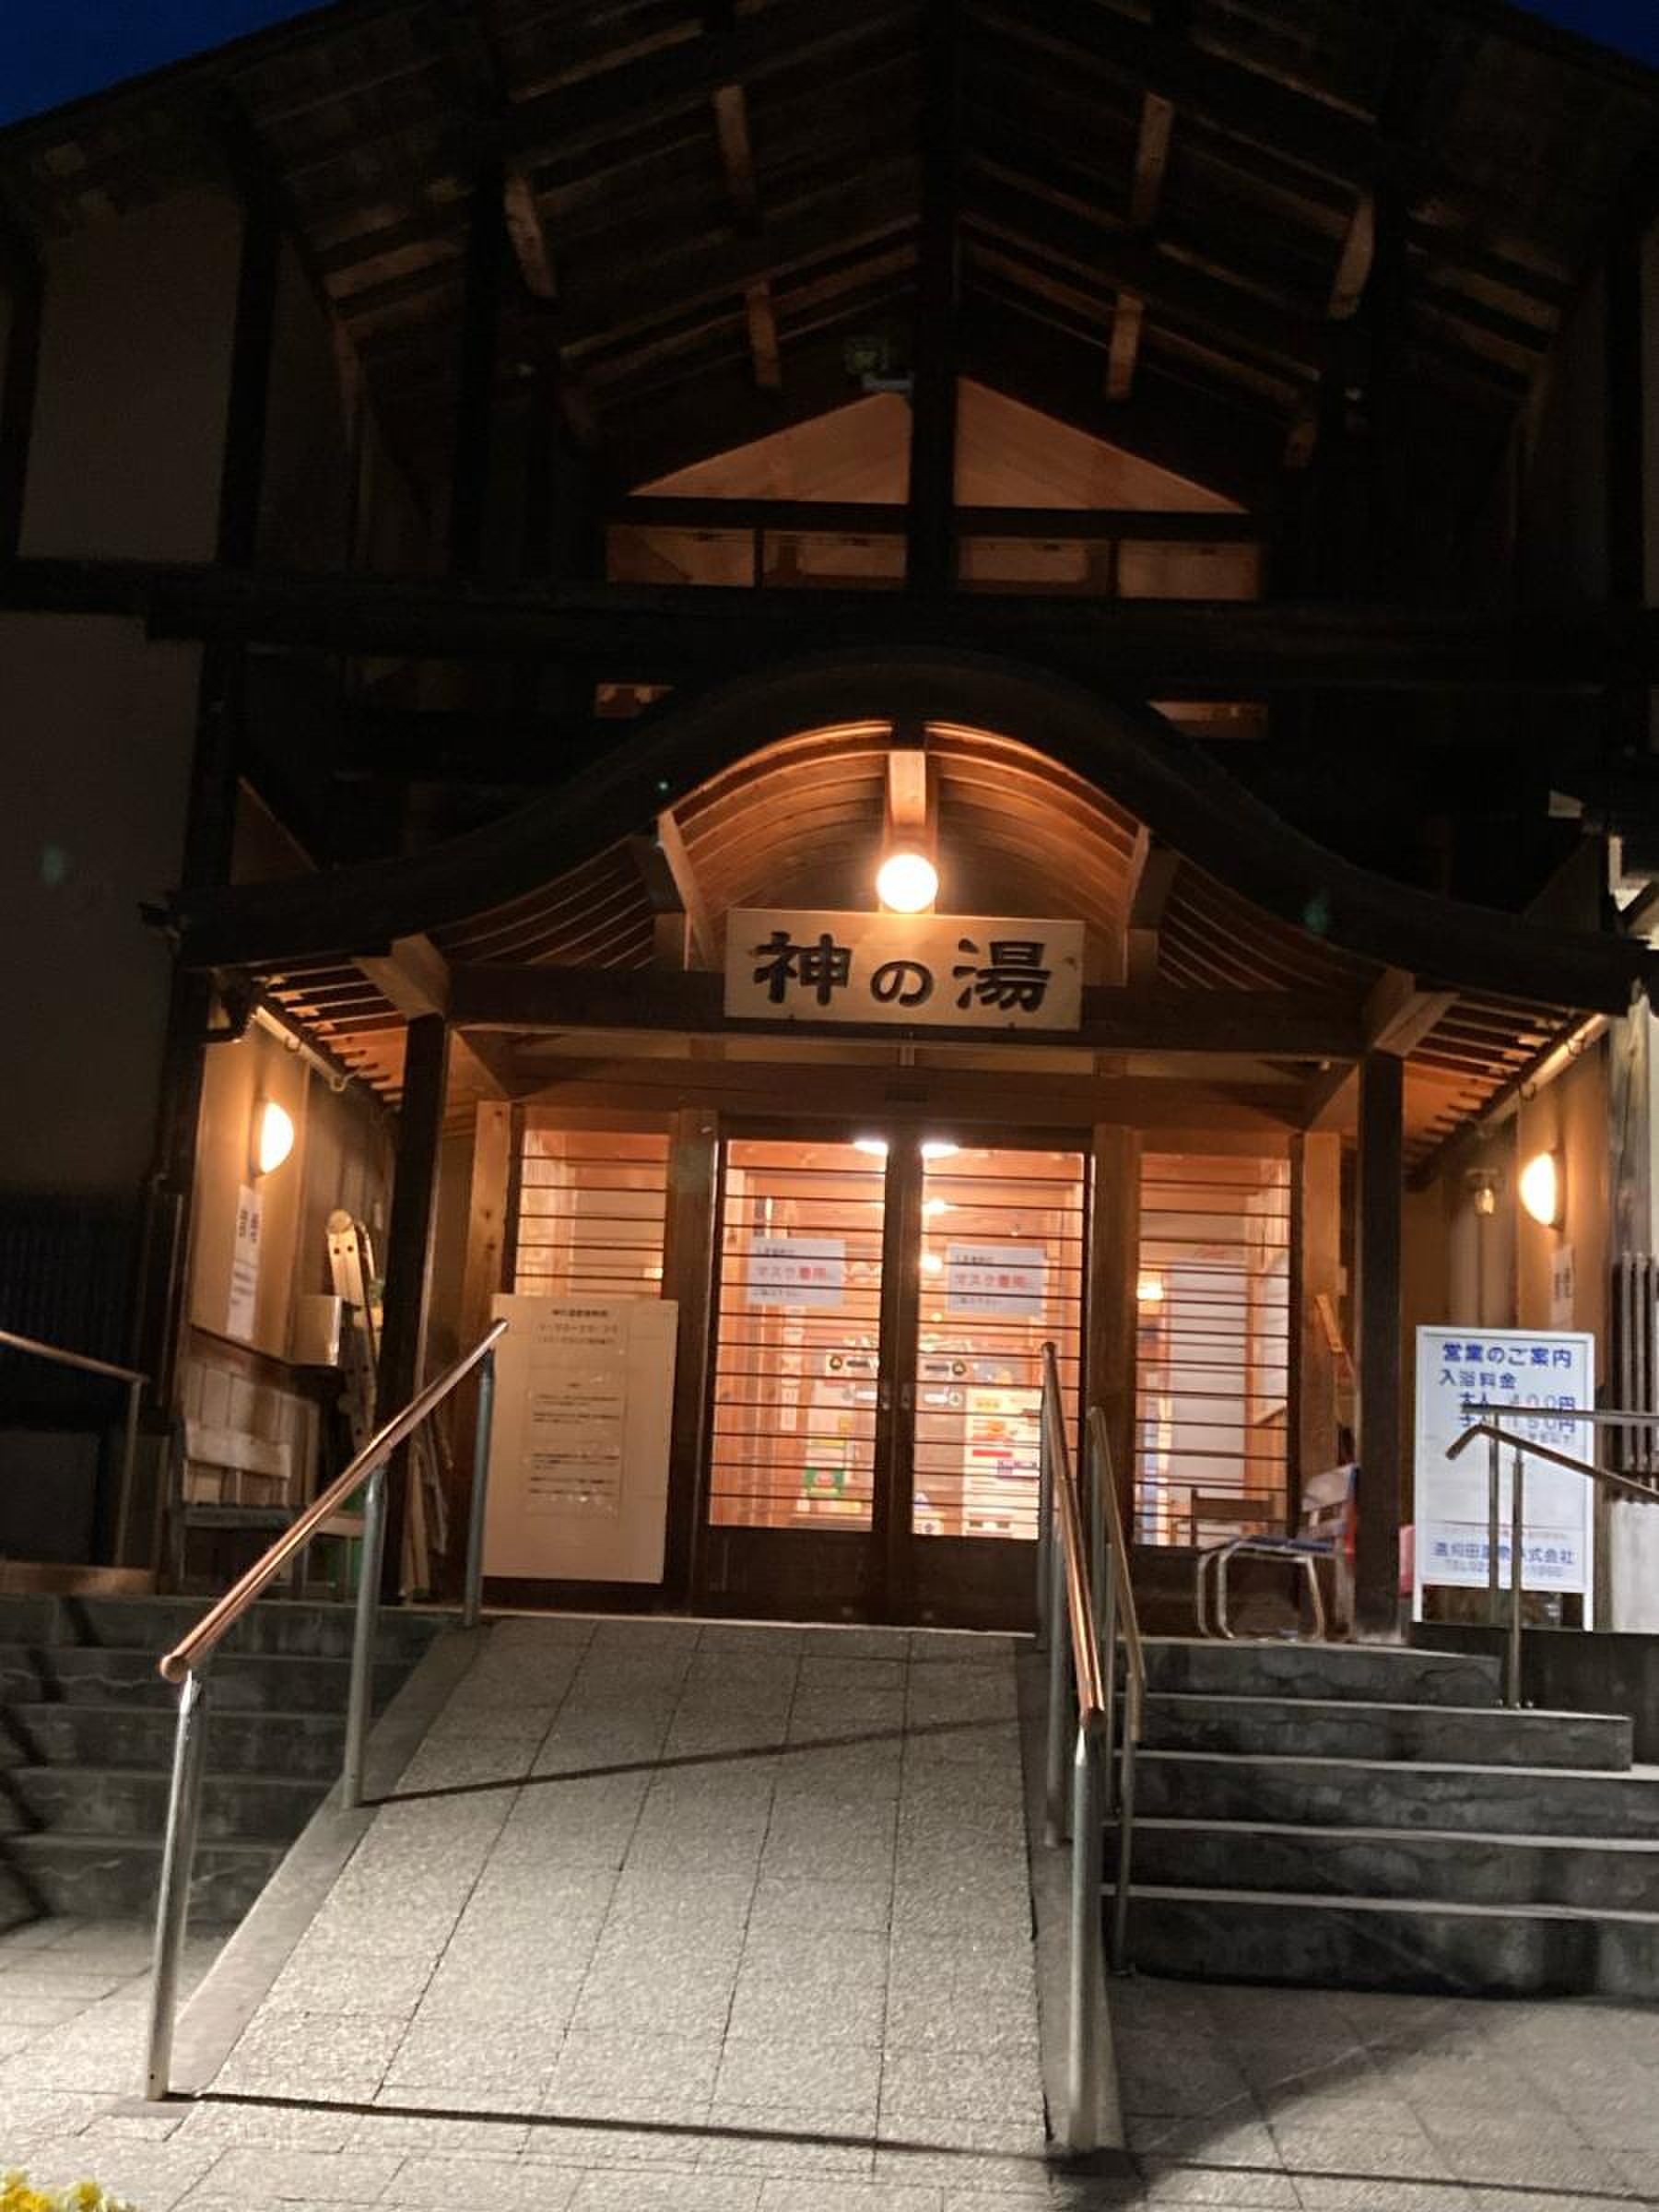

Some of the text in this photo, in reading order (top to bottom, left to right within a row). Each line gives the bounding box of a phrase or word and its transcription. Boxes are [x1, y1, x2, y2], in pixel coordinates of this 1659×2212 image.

[752, 931, 1052, 1012] 神の湯
[1443, 1343, 1571, 1368] 営業のご案内
[1439, 1370, 1516, 1388] 入浴料金
